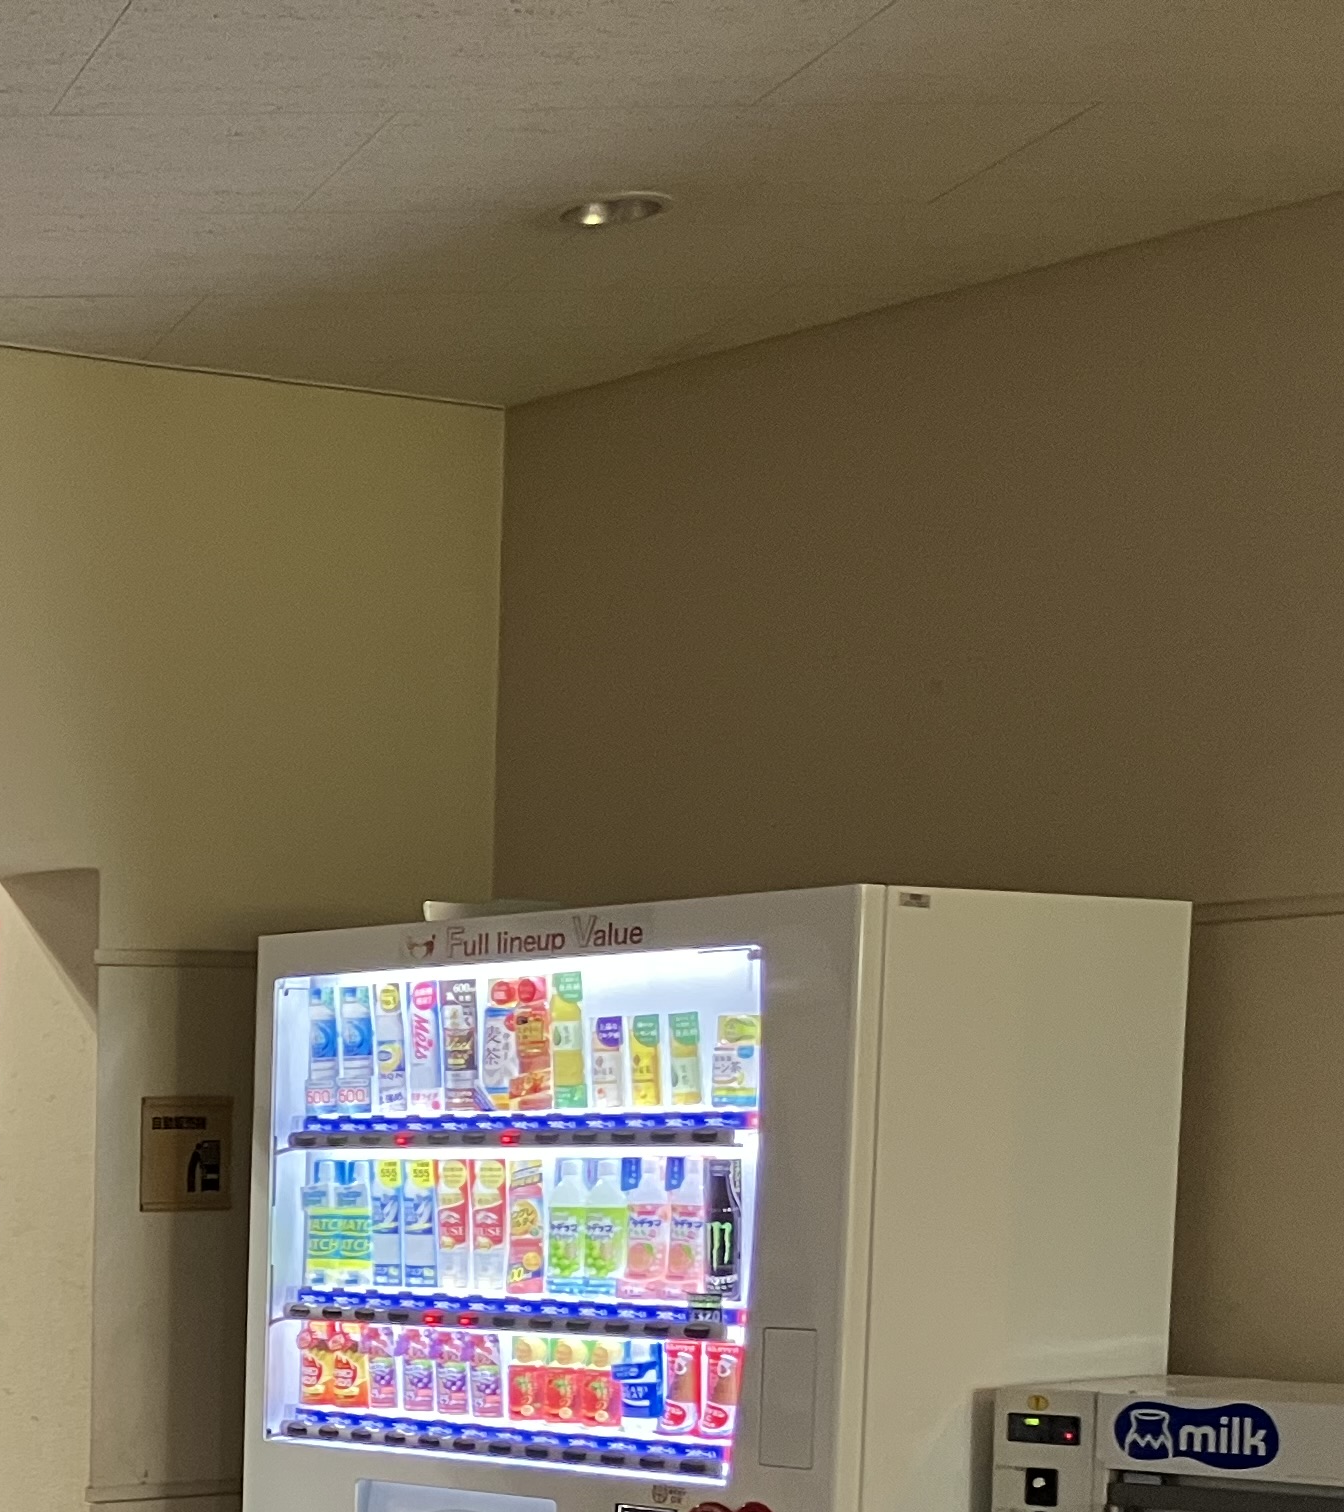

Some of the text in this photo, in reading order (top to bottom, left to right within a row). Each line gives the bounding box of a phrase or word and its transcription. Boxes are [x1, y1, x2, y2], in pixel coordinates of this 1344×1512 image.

[444, 915, 645, 960] Full lineup Value
[1178, 1415, 1268, 1457] milk
